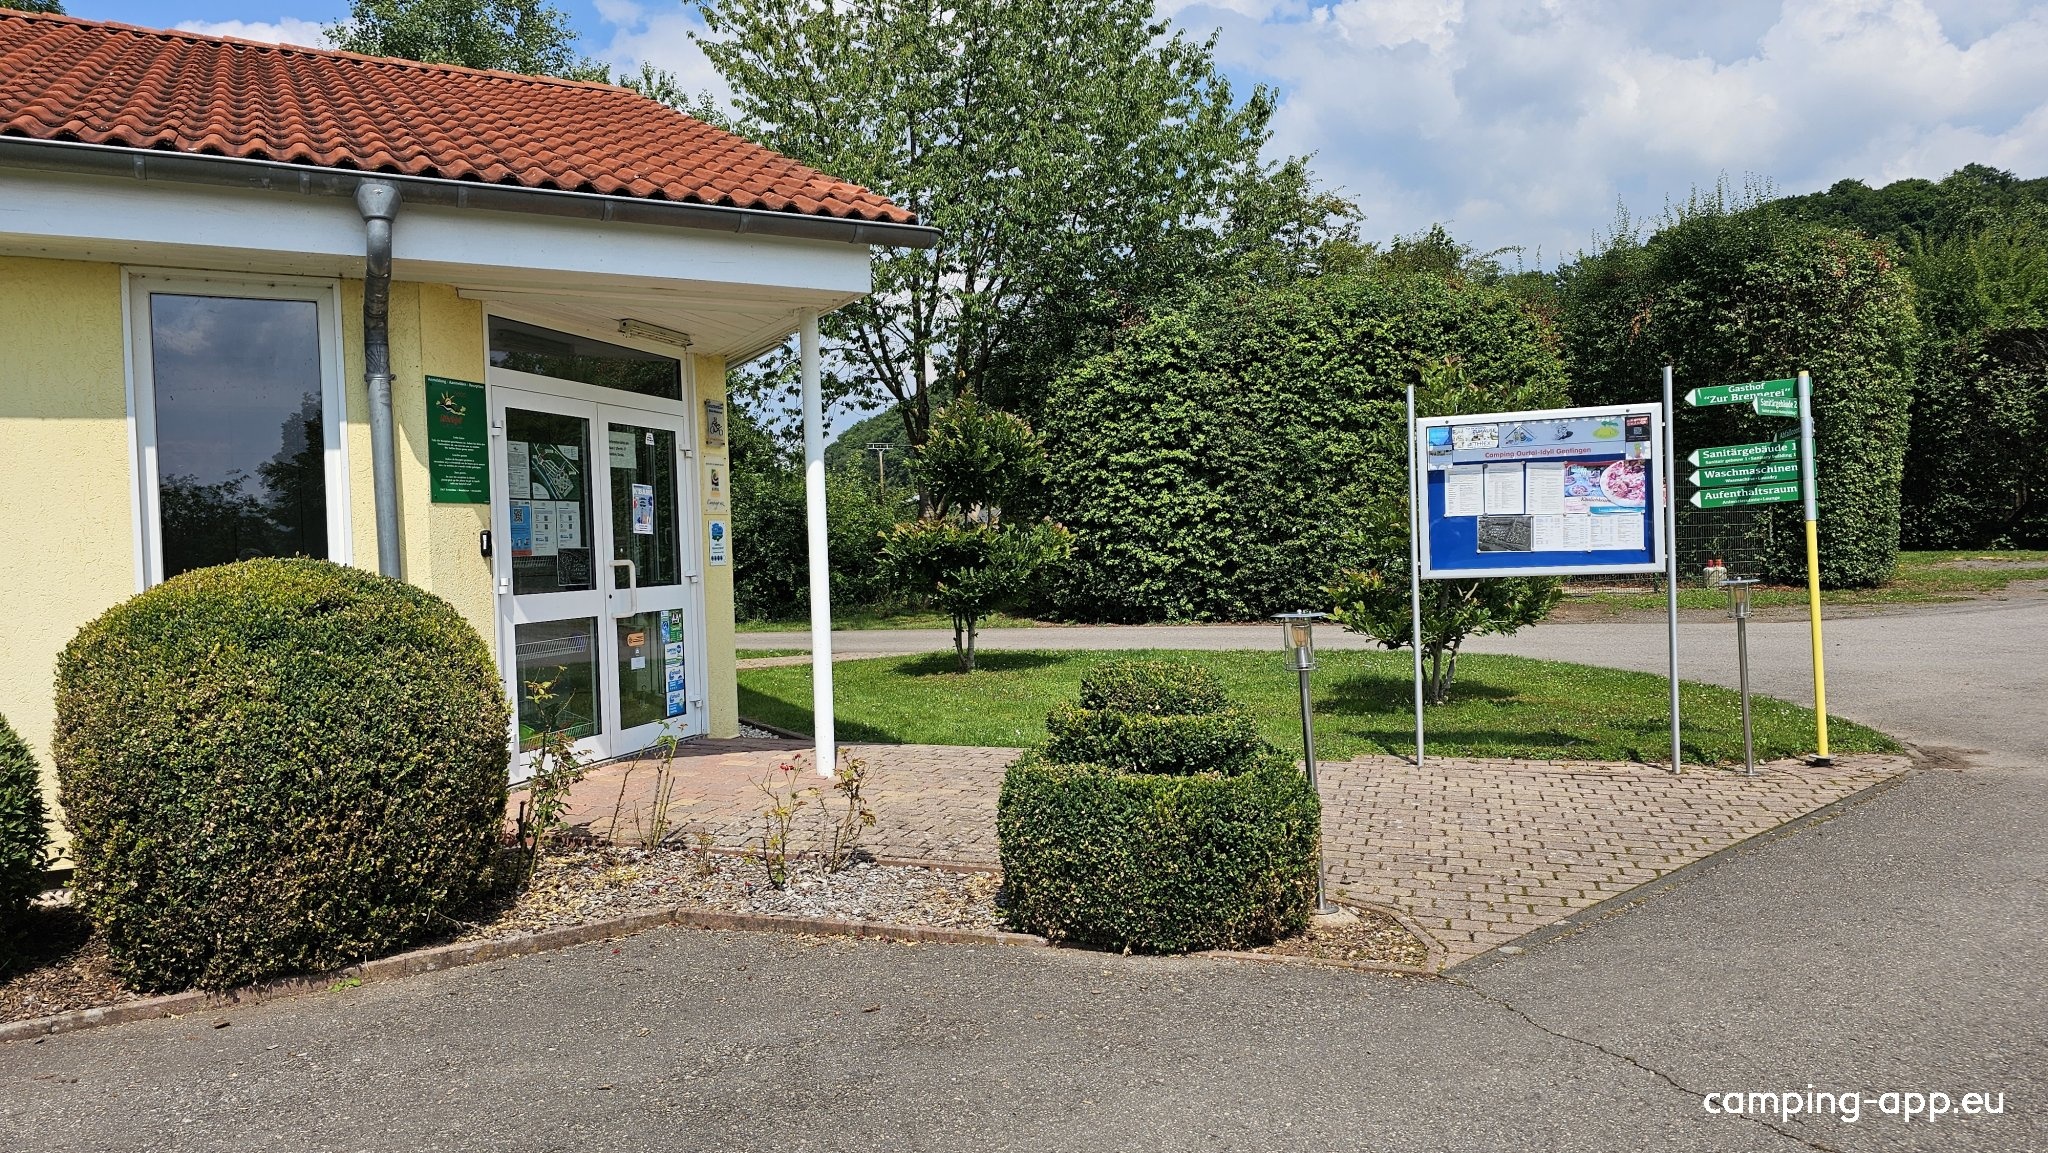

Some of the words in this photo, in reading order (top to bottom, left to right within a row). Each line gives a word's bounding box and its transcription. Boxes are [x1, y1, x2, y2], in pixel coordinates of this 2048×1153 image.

[1728, 382, 1766, 393] Gasthof
[1516, 448, 1554, 456] Ourtal-Idyll
[1702, 443, 1788, 459] Sanitärgebäude
[1792, 442, 1797, 451] 1
[1704, 464, 1798, 479] Waschmaschinen
[1704, 485, 1798, 500] Aufenthaltsraum
